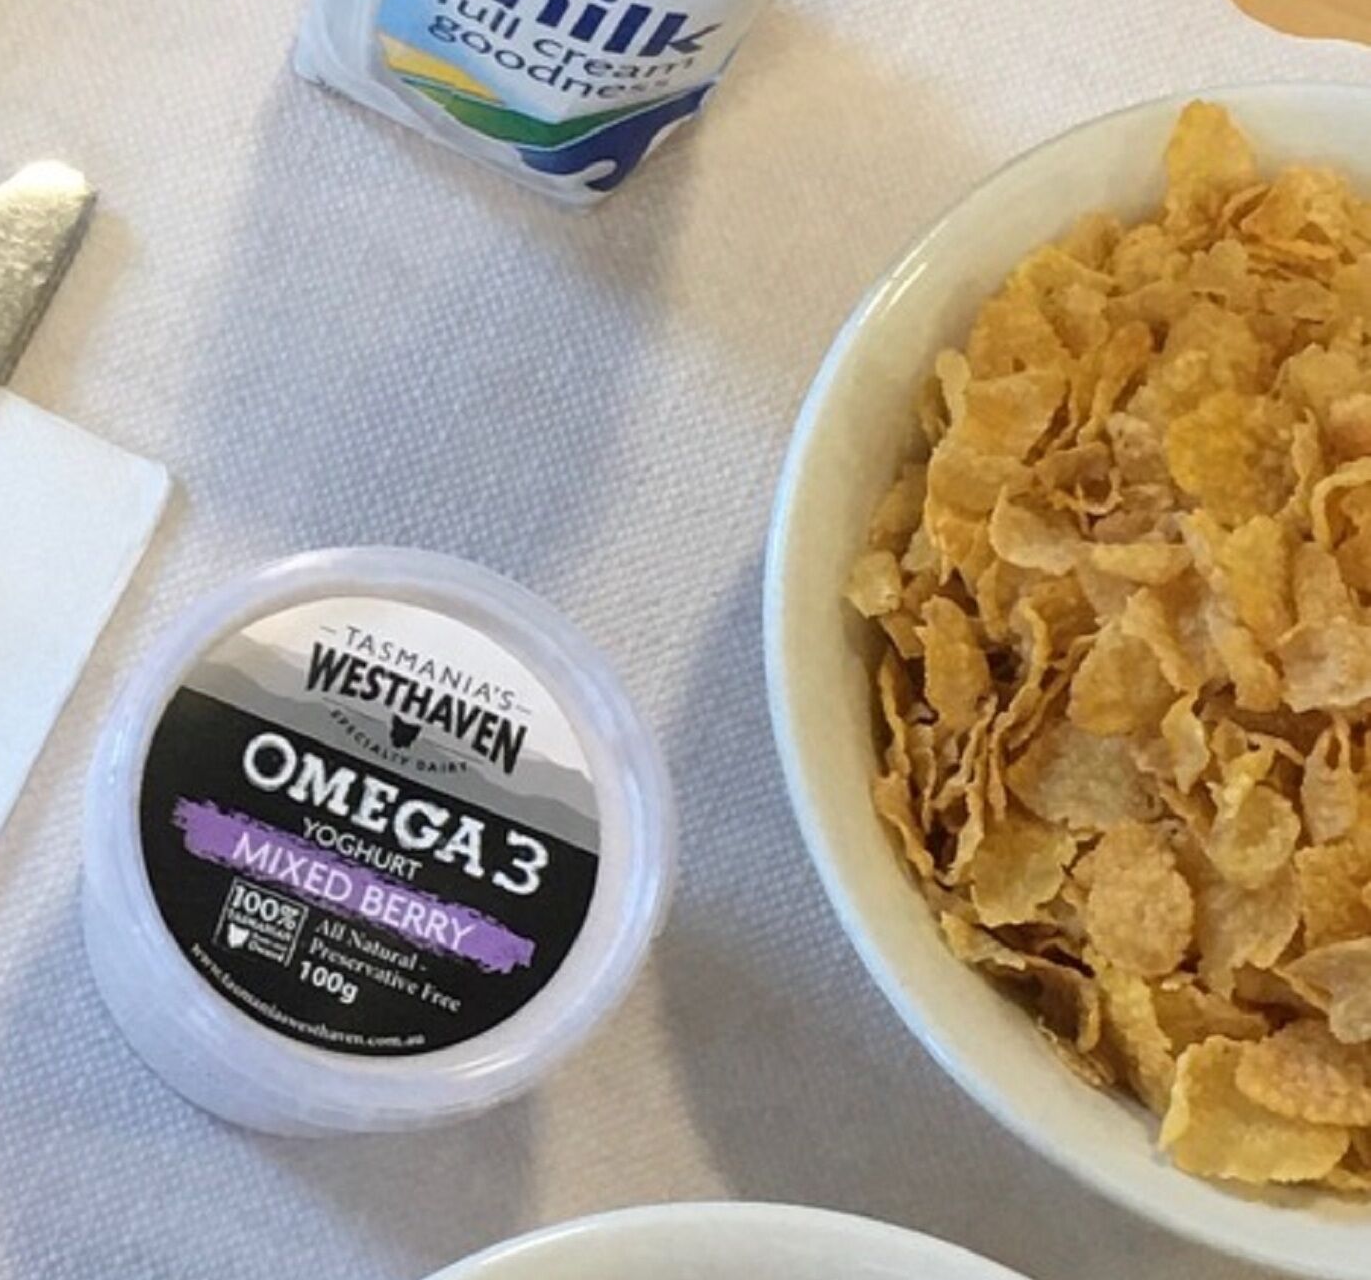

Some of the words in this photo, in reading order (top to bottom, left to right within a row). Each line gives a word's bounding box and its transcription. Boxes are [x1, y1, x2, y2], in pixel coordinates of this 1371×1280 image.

[533, 37, 694, 79] cream
[345, 625, 516, 712] TASMANIA'S
[306, 640, 528, 775] WESTHAVEN
[242, 731, 486, 878] OMEGA
[492, 829, 550, 896] 3
[303, 816, 424, 881] YOGHURT
[231, 831, 353, 903] MIXED
[360, 884, 479, 953] BERRY
[231, 884, 300, 931] 100%
[298, 959, 360, 1005] 100g
[308, 935, 419, 996] Preservative
[420, 977, 463, 1013] Free
[350, 928, 418, 972] Natural
